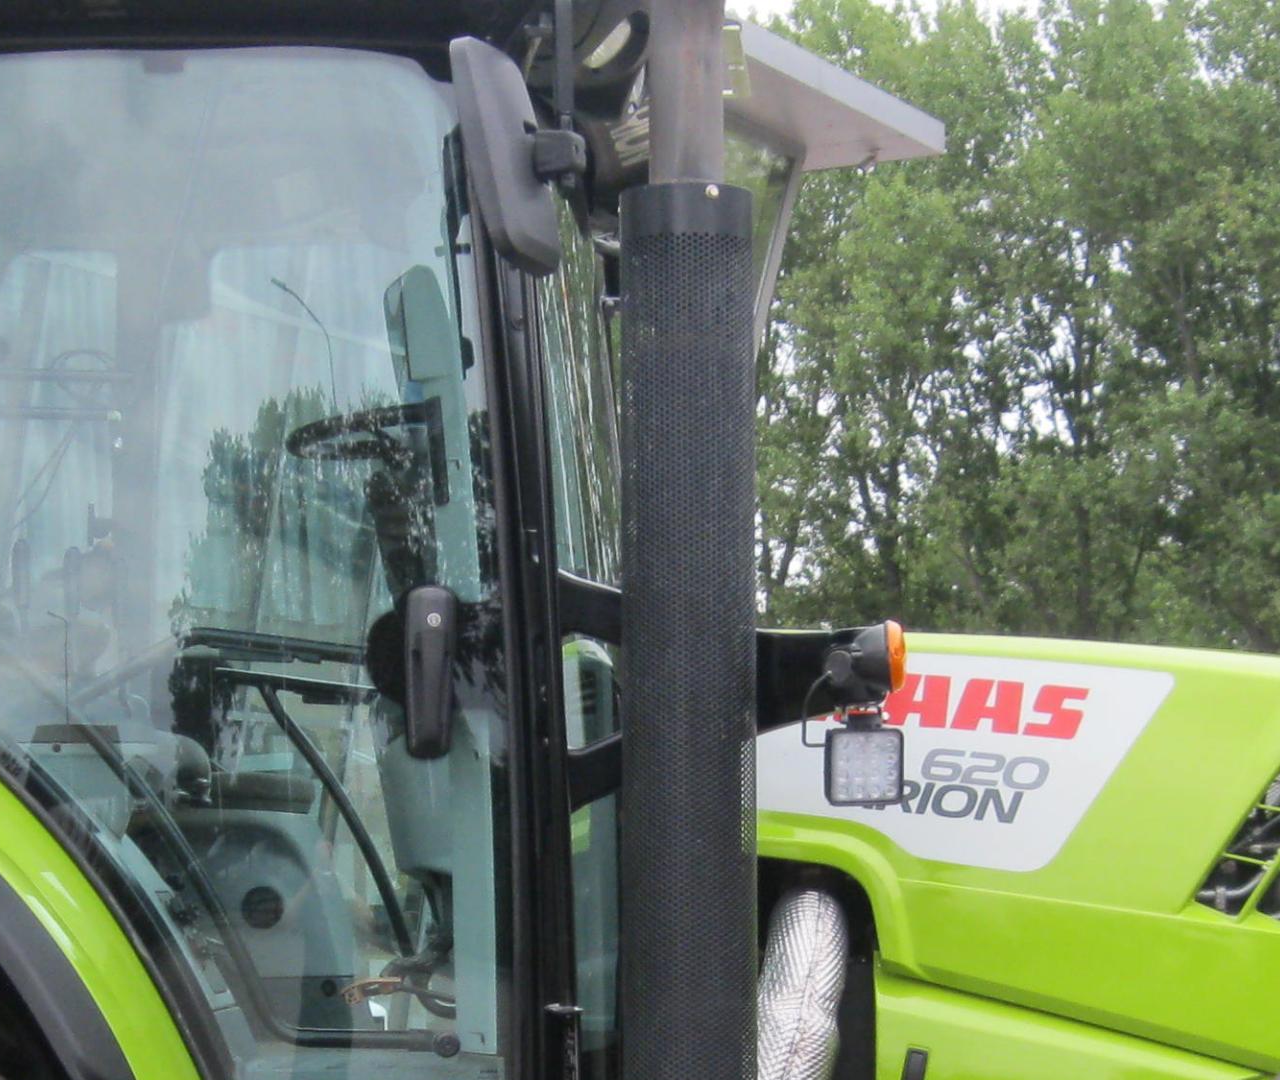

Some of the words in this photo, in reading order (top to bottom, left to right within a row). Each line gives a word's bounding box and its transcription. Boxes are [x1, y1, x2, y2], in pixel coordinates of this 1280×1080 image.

[816, 674, 1089, 739] AAS
[921, 748, 1050, 790] 620
[862, 780, 1024, 824] RION
